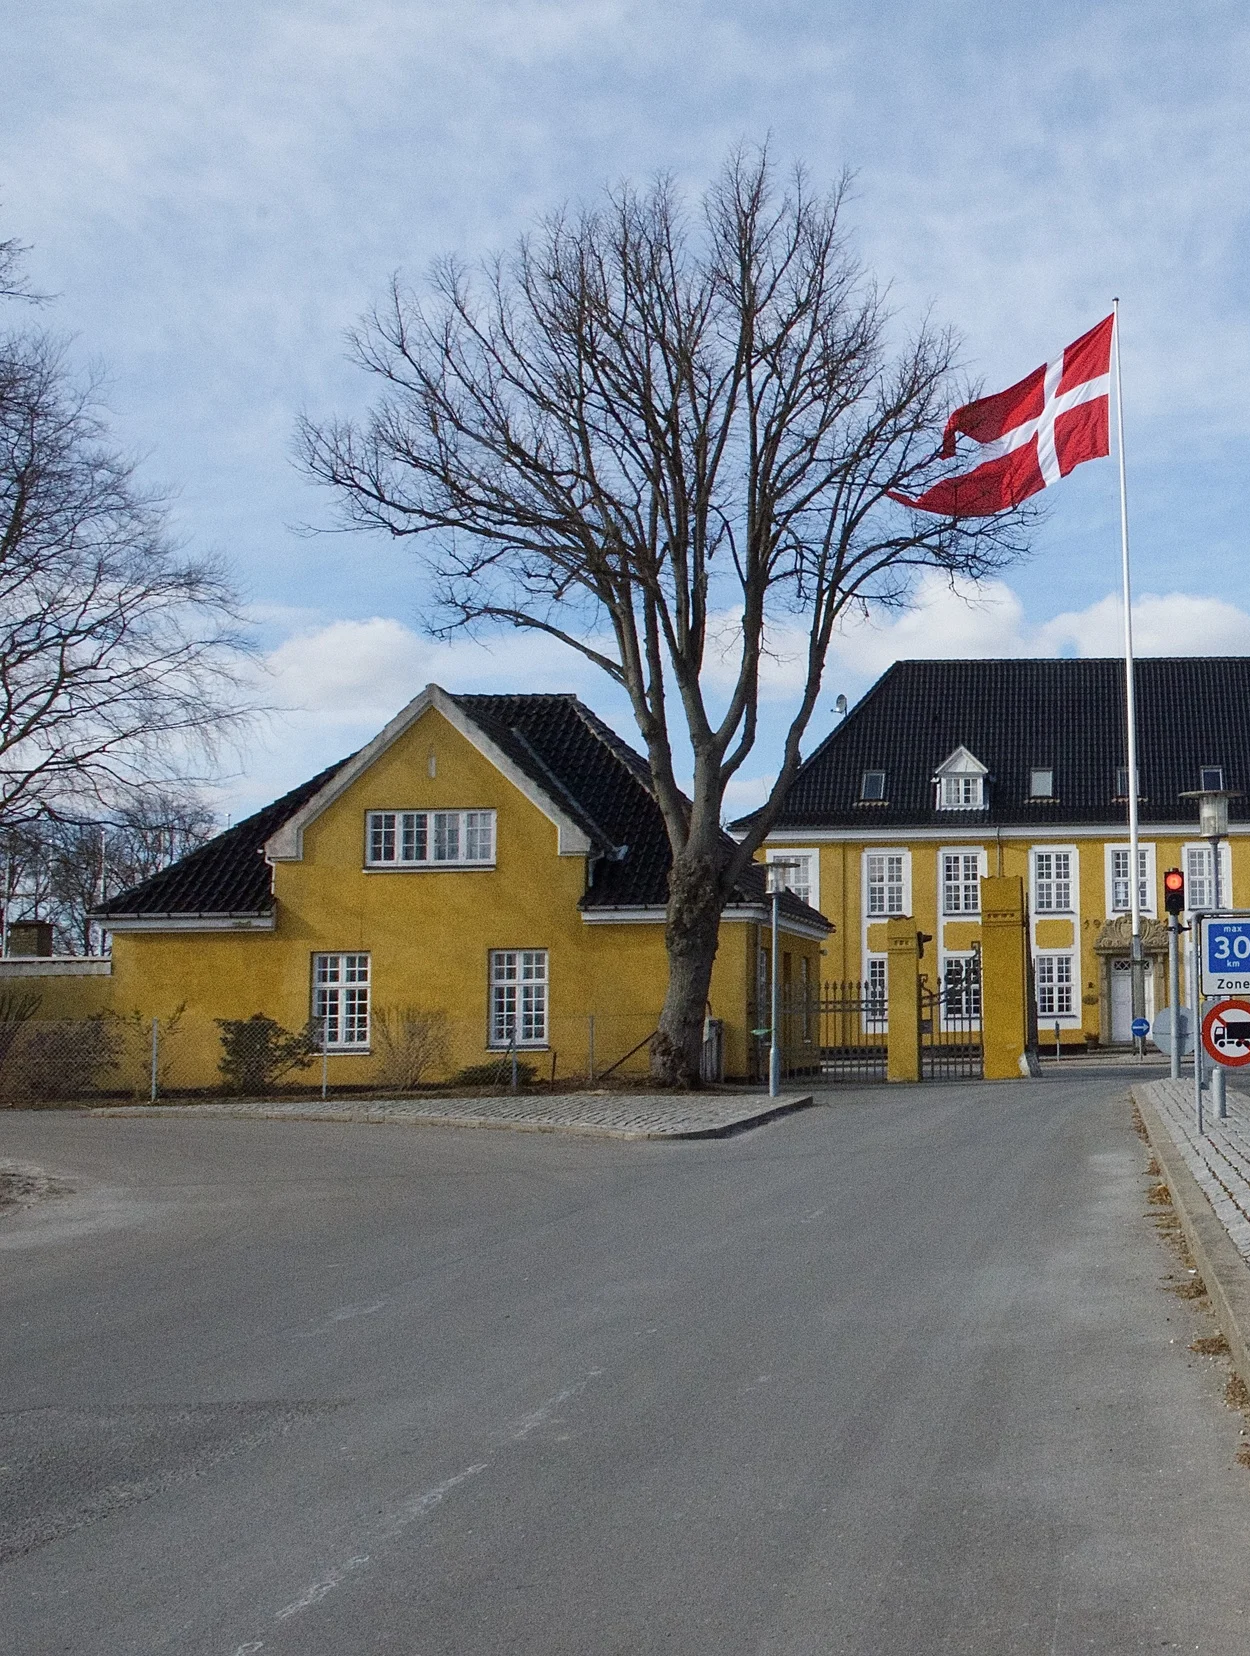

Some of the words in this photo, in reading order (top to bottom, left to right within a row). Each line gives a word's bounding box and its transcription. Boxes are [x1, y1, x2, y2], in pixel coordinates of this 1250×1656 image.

[1223, 925, 1243, 933] max
[1226, 959, 1240, 967] km
[1217, 978, 1250, 989] Zone
